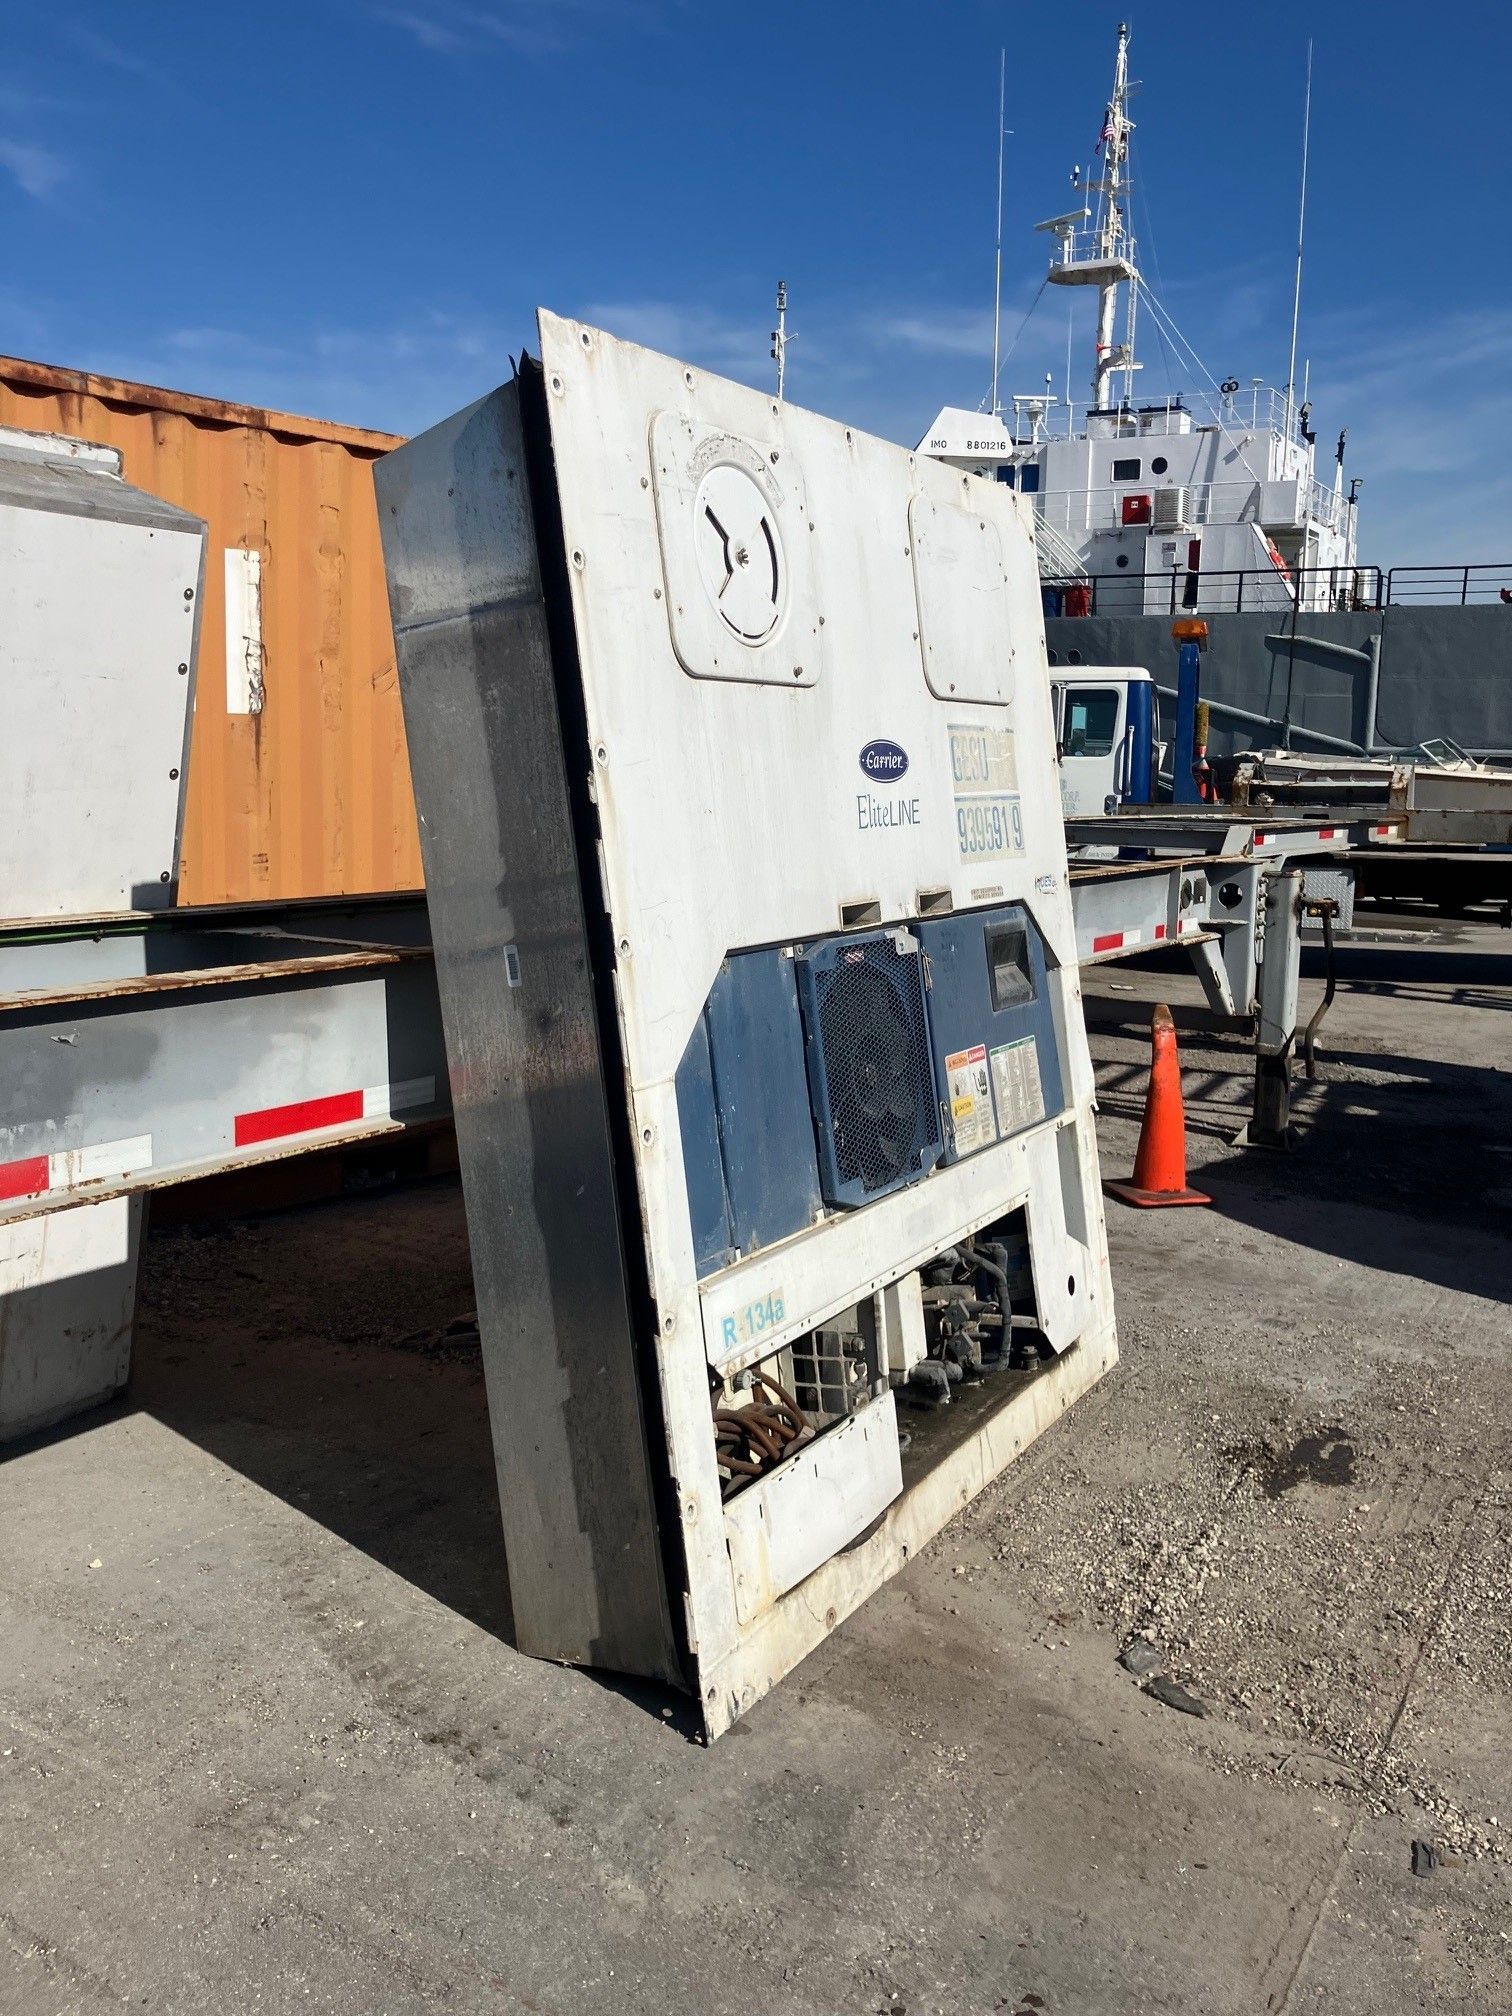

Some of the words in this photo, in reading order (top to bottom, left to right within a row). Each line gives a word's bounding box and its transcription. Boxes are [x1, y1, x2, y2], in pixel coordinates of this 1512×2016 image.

[930, 440, 947, 449] IMO
[966, 440, 1006, 450] 8801216
[865, 750, 904, 769] Carrier
[856, 793, 921, 829] EliteLINE
